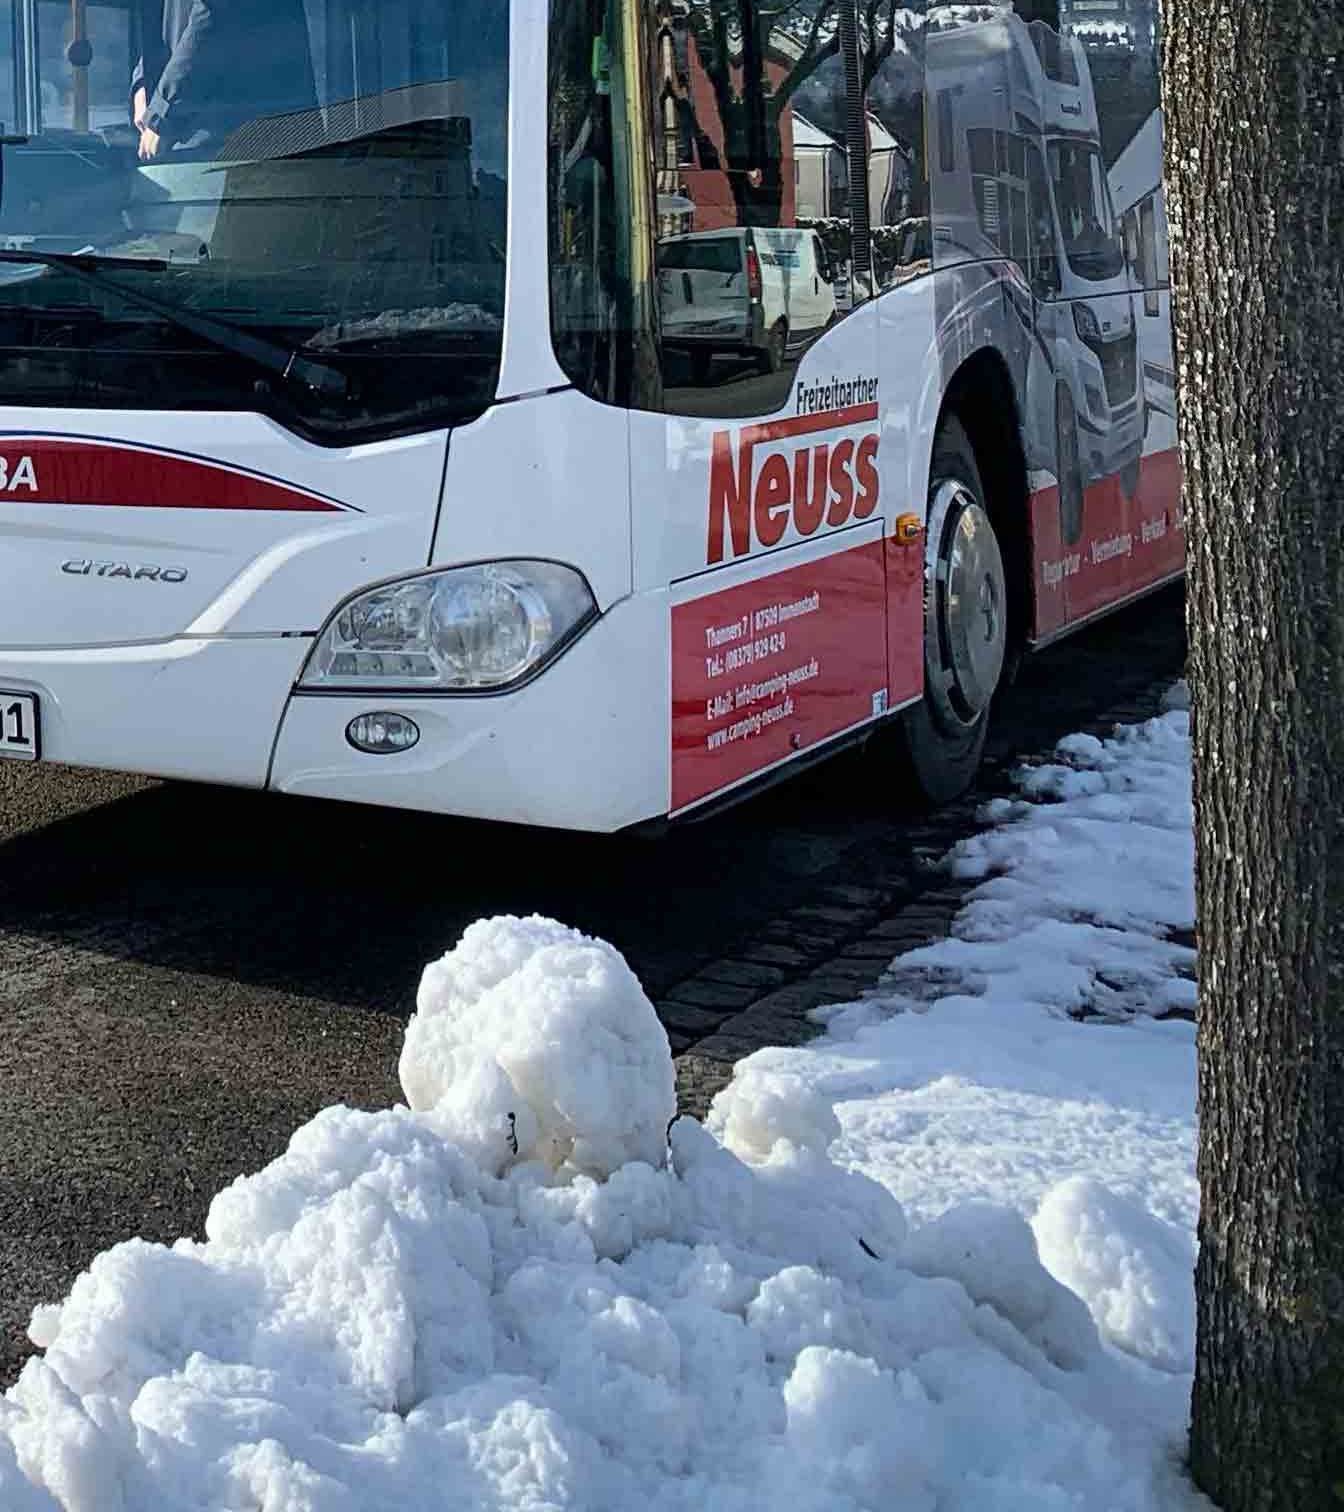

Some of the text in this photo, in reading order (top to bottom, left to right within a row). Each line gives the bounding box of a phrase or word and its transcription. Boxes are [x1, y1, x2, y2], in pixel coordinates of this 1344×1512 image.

[796, 376, 879, 415] Freizeitpartner
[707, 431, 881, 566] Neuss
[61, 559, 188, 583] CITARO
[707, 695, 794, 751] www.camping-neuss.de
